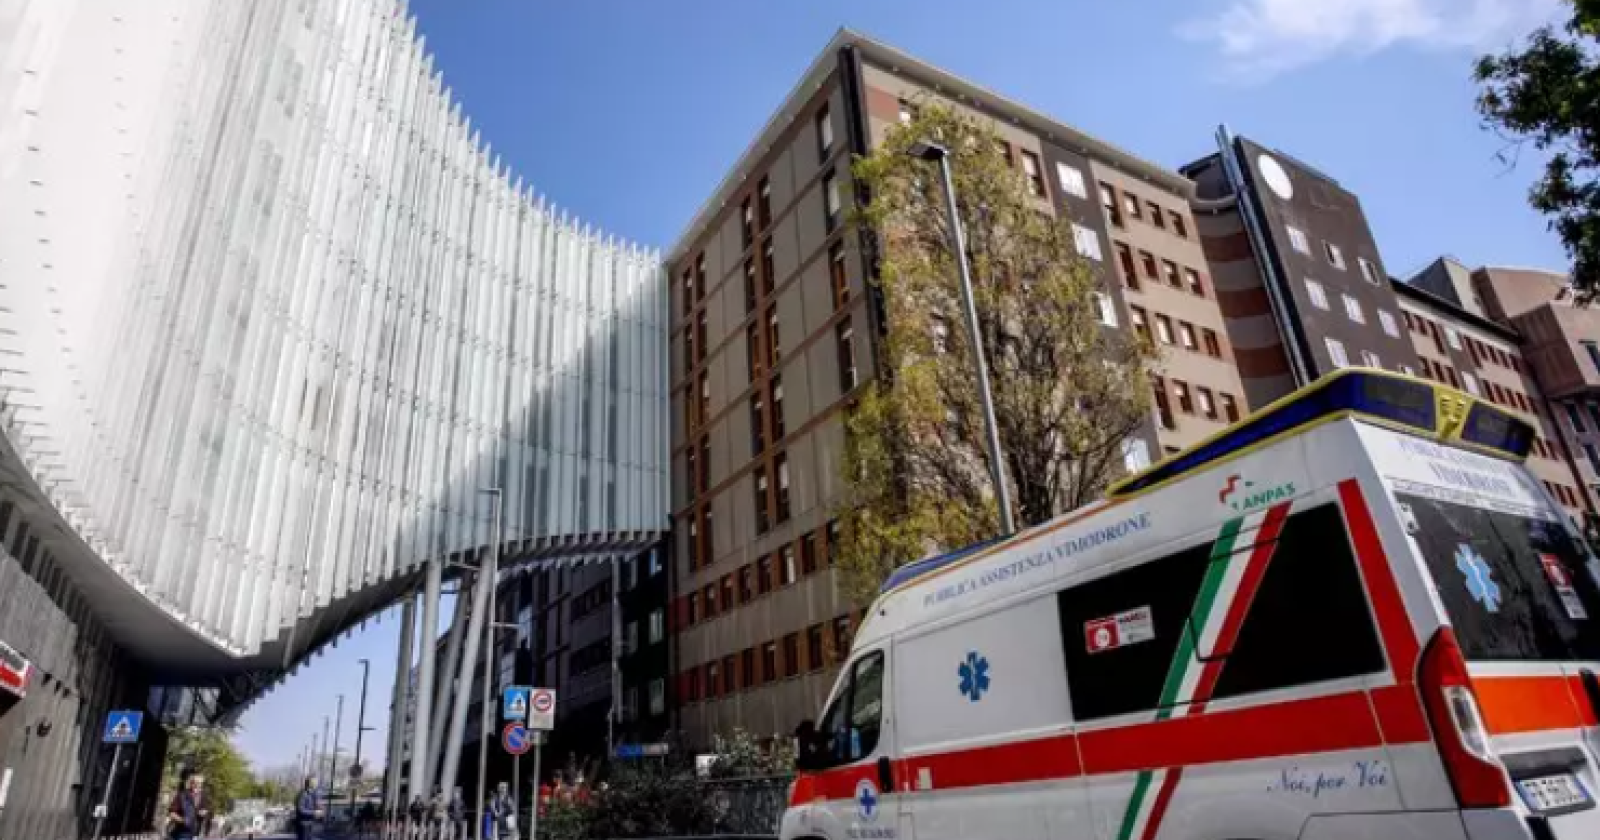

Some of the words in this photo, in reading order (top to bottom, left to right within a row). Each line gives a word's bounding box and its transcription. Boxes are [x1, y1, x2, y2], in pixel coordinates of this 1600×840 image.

[1240, 481, 1295, 510] ANPAS
[923, 579, 977, 608] PUBBLICA
[979, 551, 1053, 588] ASSISTENZA
[1056, 511, 1151, 558] VIMODRONE
[1312, 771, 1346, 798] per
[1354, 759, 1388, 787] Voi
